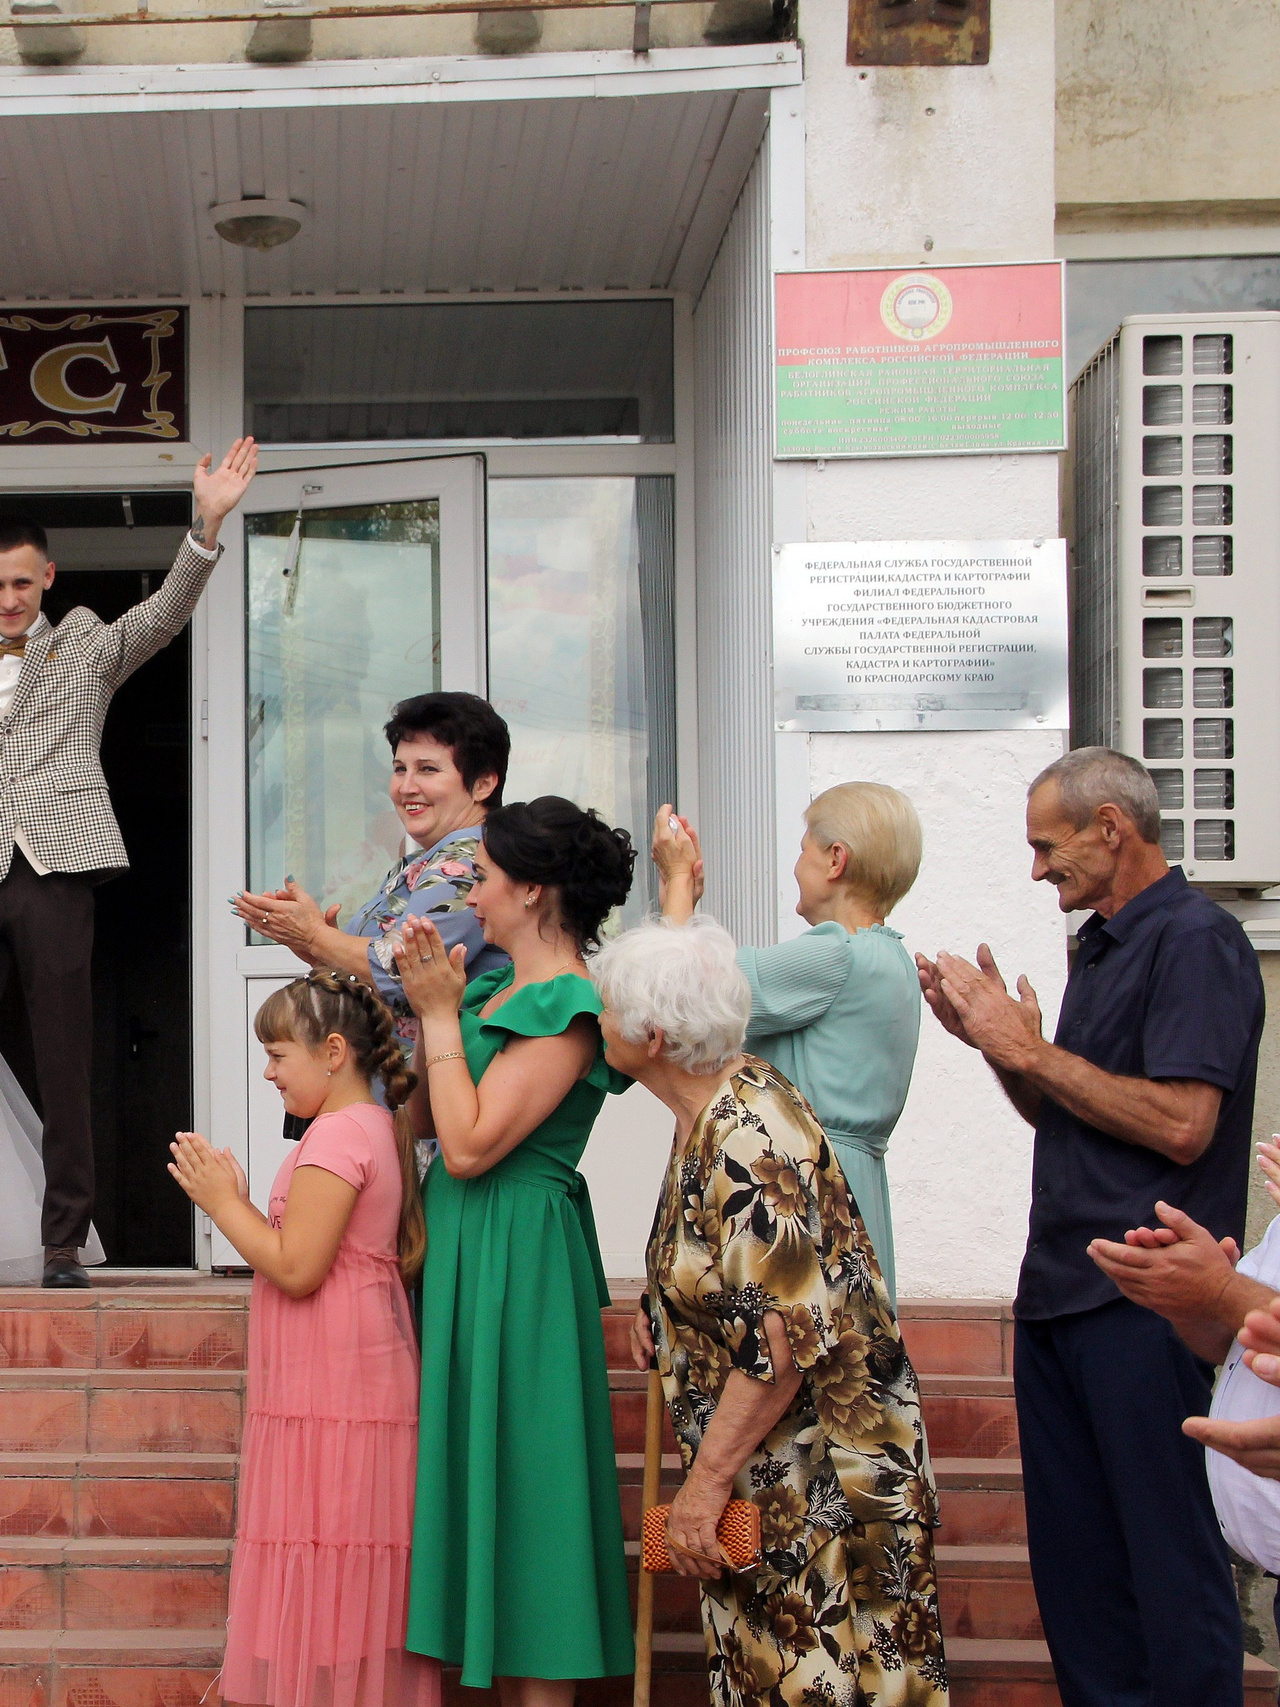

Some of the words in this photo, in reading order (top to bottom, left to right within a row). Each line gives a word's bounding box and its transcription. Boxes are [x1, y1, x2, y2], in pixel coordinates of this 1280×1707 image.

[778, 347, 841, 356] ПРОФСОЮЗ
[845, 345, 920, 354] РАБОТНИКОВ
[924, 340, 1059, 352] АГРОПРОМЫШЛЕННОГО
[808, 357, 876, 366] КОМПЛЕКСА
[881, 353, 954, 363] РОССИЙСКОЙ
[959, 352, 1029, 361] ФЕДЕРАЦИИ
[805, 560, 881, 570] ФЕДЕРАЛЬНАЯ
[884, 559, 928, 568] СЛУЖБА
[931, 557, 1032, 568] ГОСУДАРСТВЕННОЙ
[944, 573, 951, 581] И
[954, 573, 1030, 581] КАРТОГРАФИИ
[853, 588, 900, 597] ФИЛИАЛ
[902, 586, 985, 596] ФЕДЕРАЛЬНОГО
[827, 602, 934, 612] ГОСУДАРСТВЕННОГО
[937, 601, 1012, 611] БЮДЖЕТНОГО
[802, 618, 874, 627] УЧРЕЖДЕНИЯ
[877, 616, 959, 626] «ФЕДЕРАЛЬНАЯ
[962, 615, 1038, 625] КАДАСТРОВАЯ
[859, 631, 900, 640] ПАЛАТА
[903, 628, 980, 639] ФЕДЕРАЛЬНОЙ
[804, 646, 851, 655] СЛУЖБЫ
[854, 643, 956, 655] ГОСУДАРСТВЕННОЙ
[959, 644, 1037, 653] РЕГИСТРАЦИИ,
[846, 660, 900, 669] КАДАСТРА
[903, 660, 910, 668] И
[912, 659, 995, 667] КАРТОГРАФИИ»
[847, 675, 861, 683] ПО
[865, 673, 961, 683] КРАСНОДАРСКОМУ
[964, 673, 995, 682] КРАЮ
